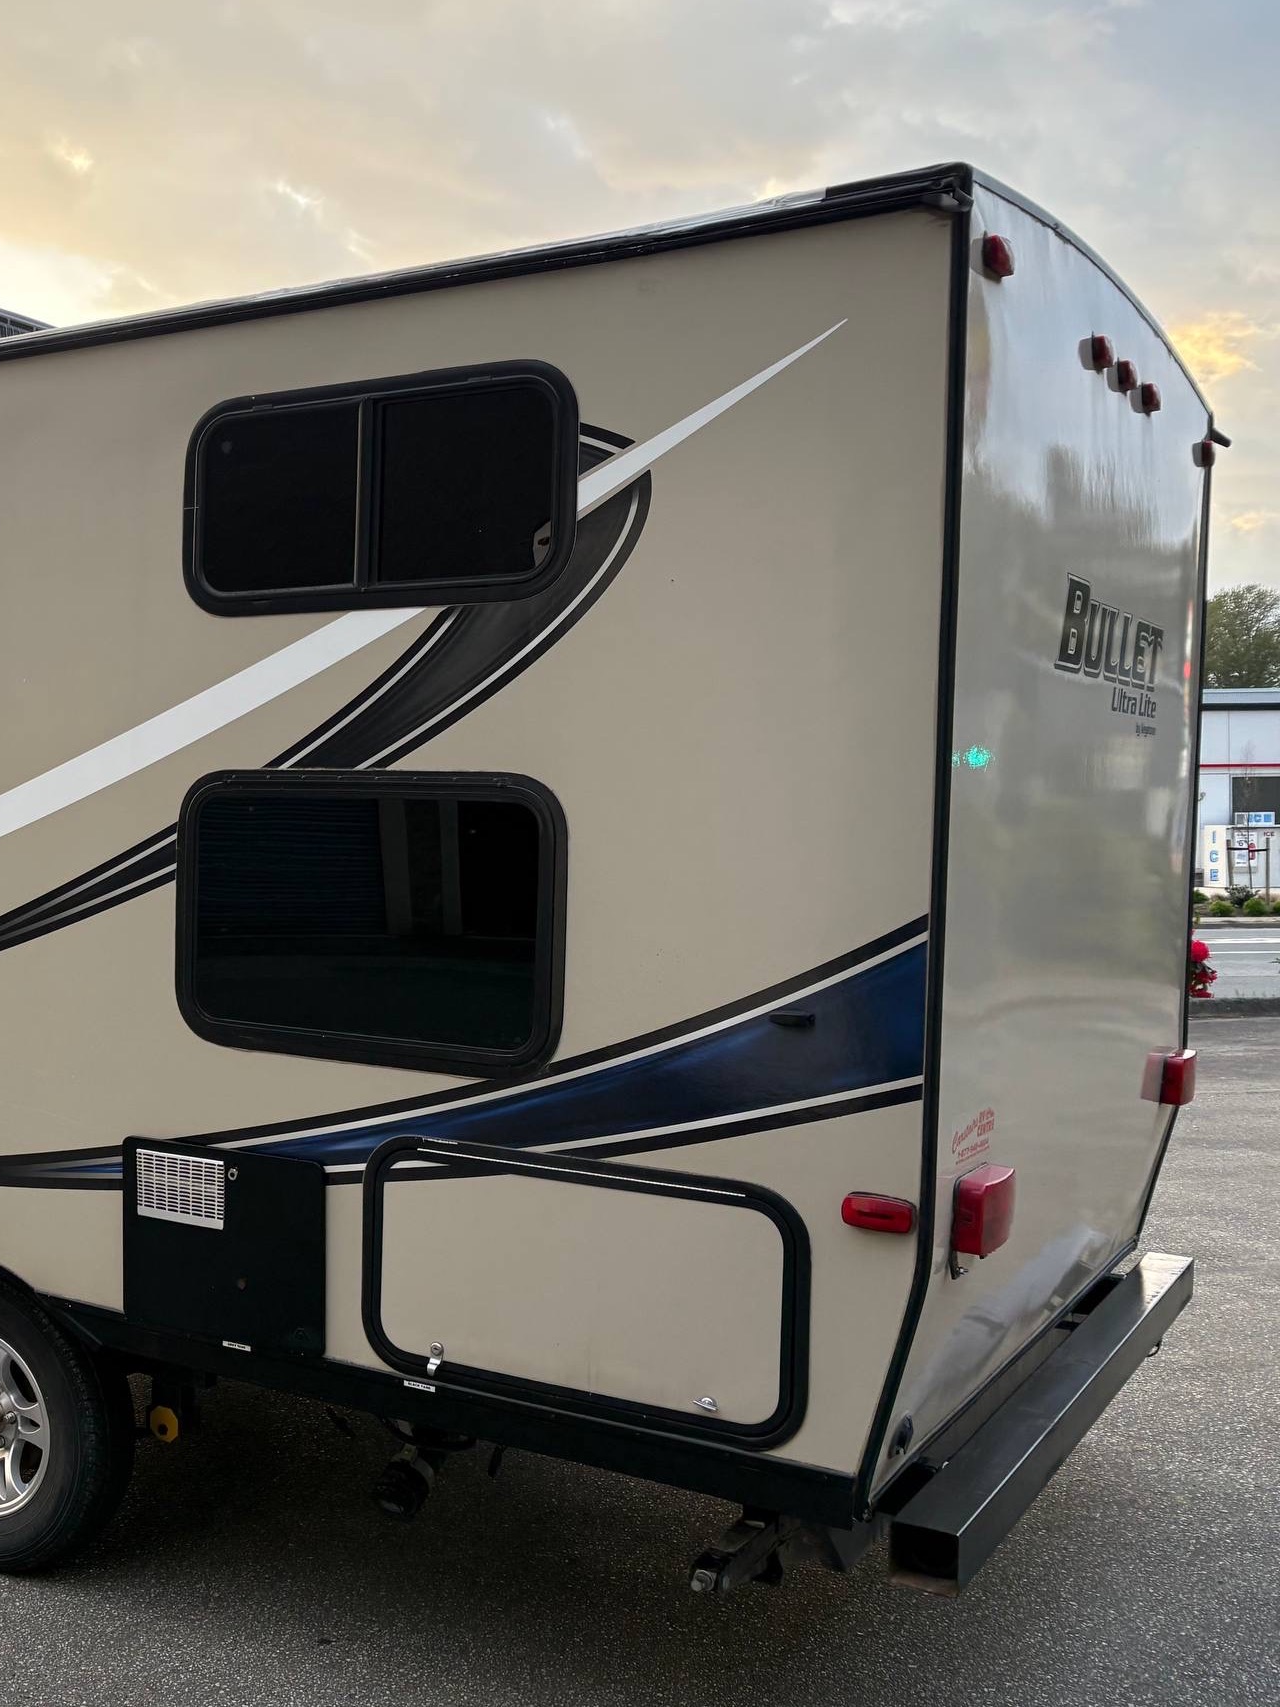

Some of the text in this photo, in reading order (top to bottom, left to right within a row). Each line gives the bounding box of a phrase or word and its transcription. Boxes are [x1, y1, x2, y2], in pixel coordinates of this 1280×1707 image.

[1054, 573, 1165, 692] BULLET
[1112, 687, 1157, 719] Ultra Lite
